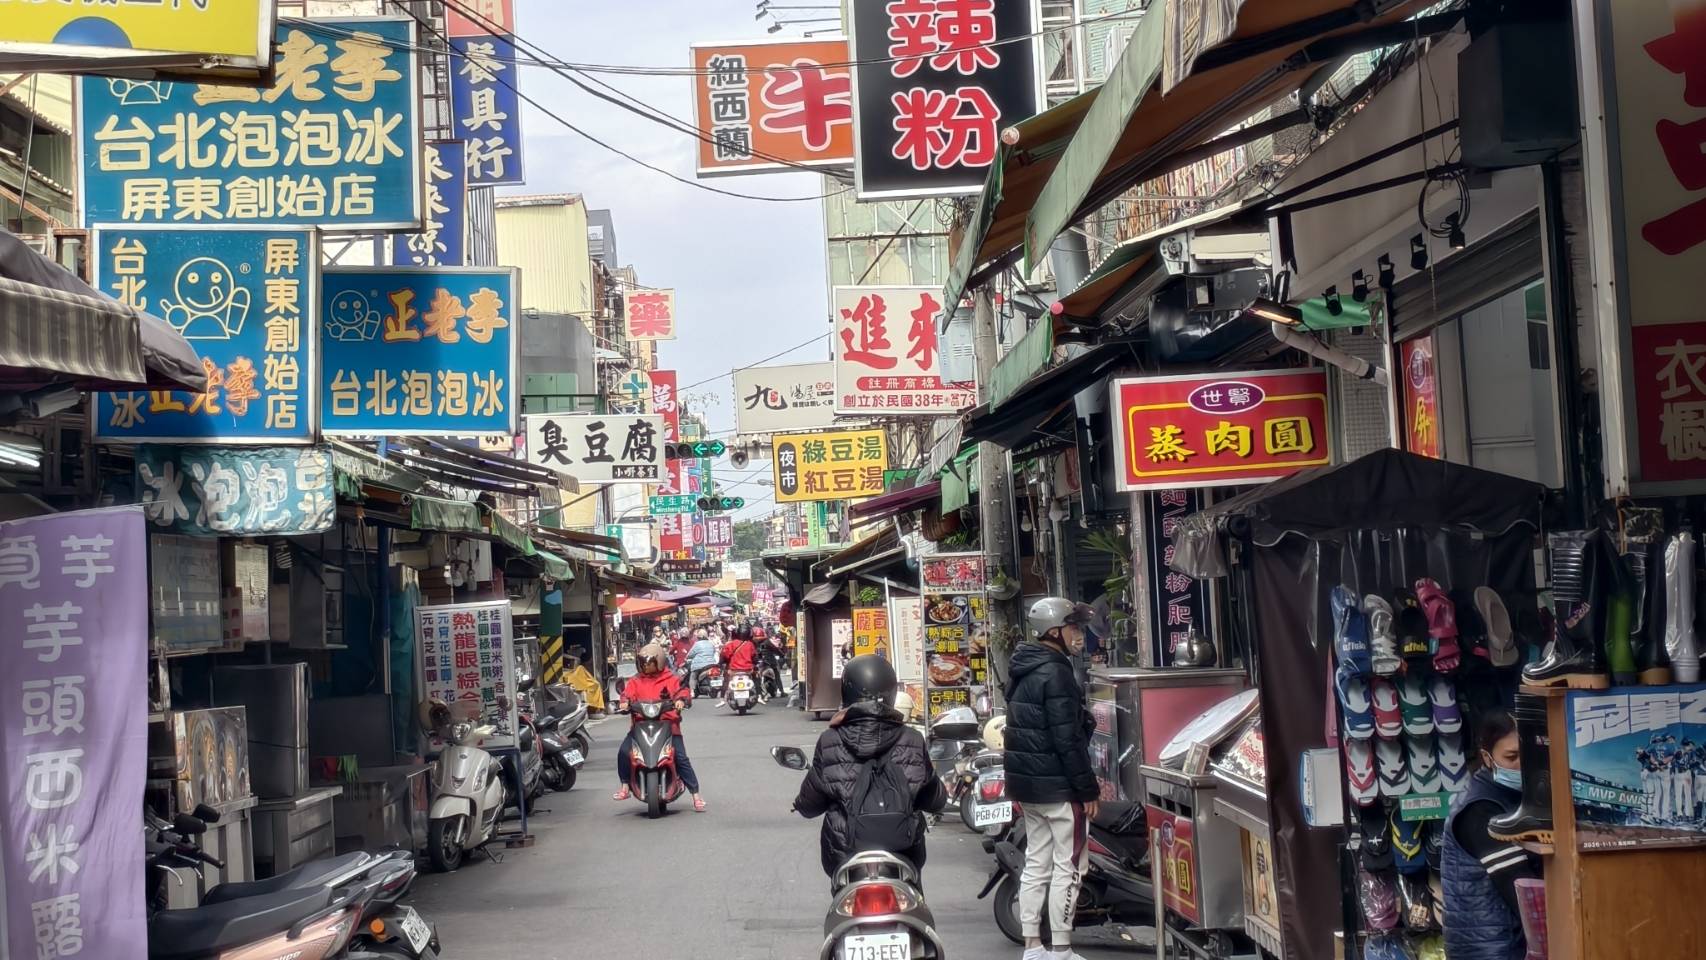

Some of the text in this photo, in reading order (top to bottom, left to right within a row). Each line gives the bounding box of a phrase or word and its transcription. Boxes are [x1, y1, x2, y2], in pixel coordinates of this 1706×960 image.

[193, 30, 401, 105] 老李
[459, 41, 513, 179] 餐具行
[709, 55, 751, 160] 紐西蘭
[94, 107, 404, 171] 台北泡泡冰
[122, 173, 376, 220] 屏東創始店
[264, 238, 300, 429] 屏東創始店
[383, 287, 509, 344] 正老李
[628, 293, 671, 336] 藥
[331, 369, 504, 416] 台北泡泡冰
[843, 394, 944, 408] 創立於民國38年
[538, 419, 658, 466] 臭豆腐
[802, 435, 882, 464] 綠豆湯
[1144, 416, 1314, 464] 蒸肉圓
[779, 450, 796, 488] 夜市
[804, 466, 884, 494] 紅豆湯
[656, 496, 690, 505] 民生路
[704, 519, 730, 544] 服飾
[1588, 786, 1616, 801] MVP
